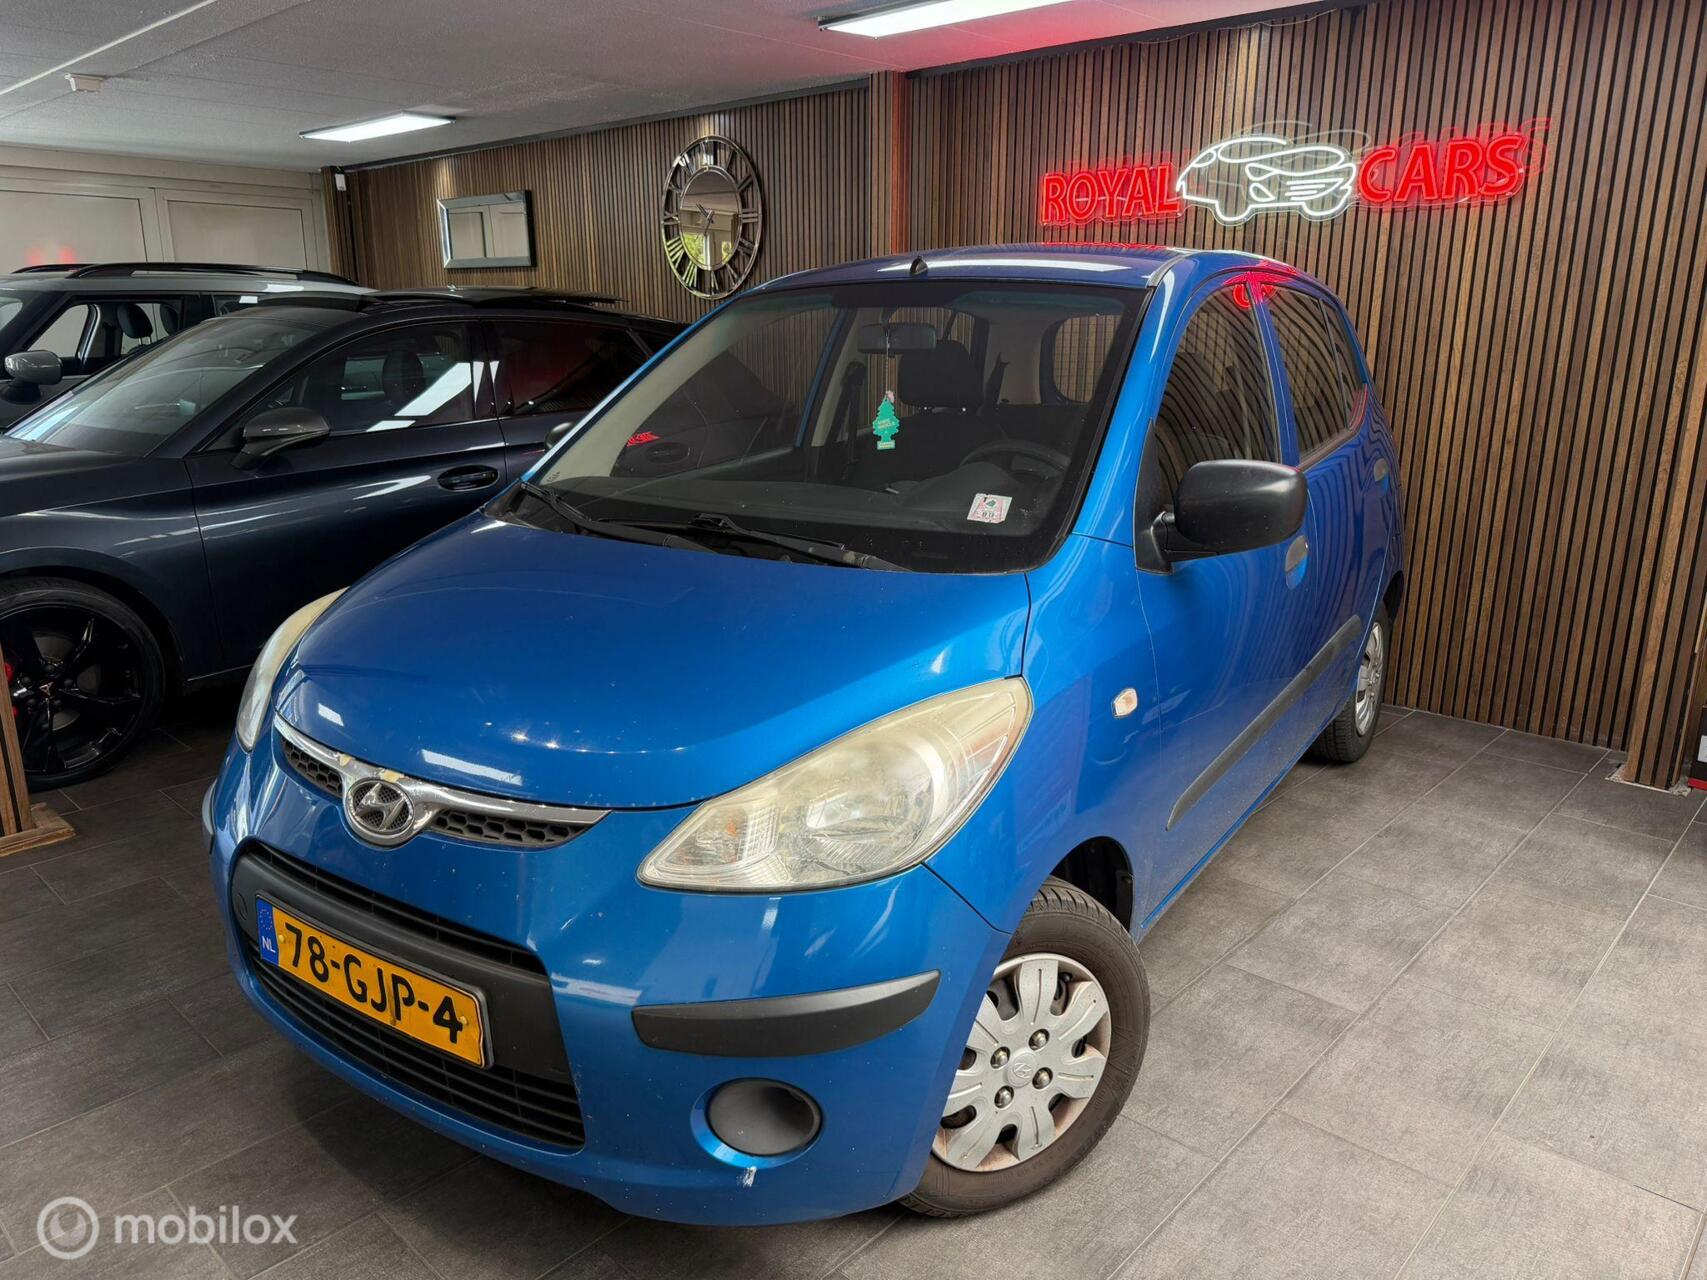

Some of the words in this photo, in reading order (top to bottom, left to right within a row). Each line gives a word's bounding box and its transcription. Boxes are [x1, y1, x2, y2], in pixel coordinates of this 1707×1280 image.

[1041, 163, 1180, 222] ROYAL
[1358, 134, 1525, 203] CARS
[262, 936, 276, 953] NL
[285, 922, 464, 1044] 78-GJP-4
